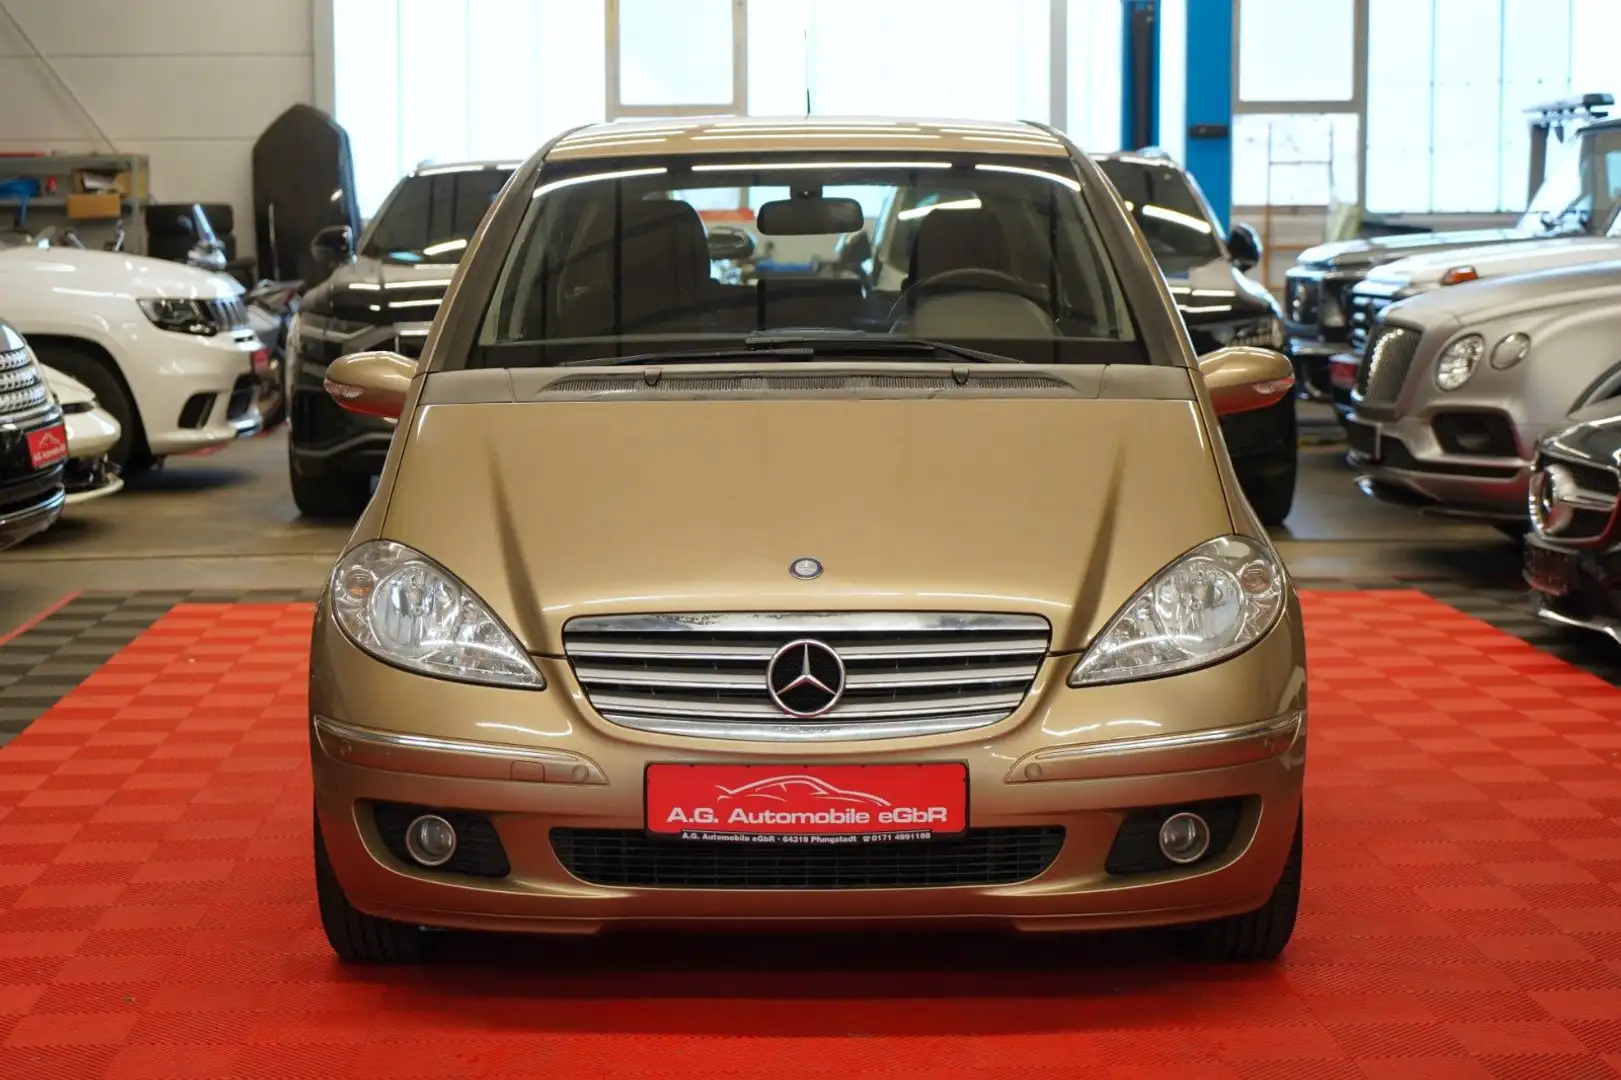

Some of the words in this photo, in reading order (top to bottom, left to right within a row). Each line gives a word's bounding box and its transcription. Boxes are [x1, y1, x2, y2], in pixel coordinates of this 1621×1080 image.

[666, 807, 719, 823] A.G.
[727, 808, 870, 824] Automobile
[878, 807, 947, 823] eGbR
[682, 832, 699, 840] A.G.
[702, 833, 750, 841] Automobile
[810, 835, 857, 845] Pfungstadt
